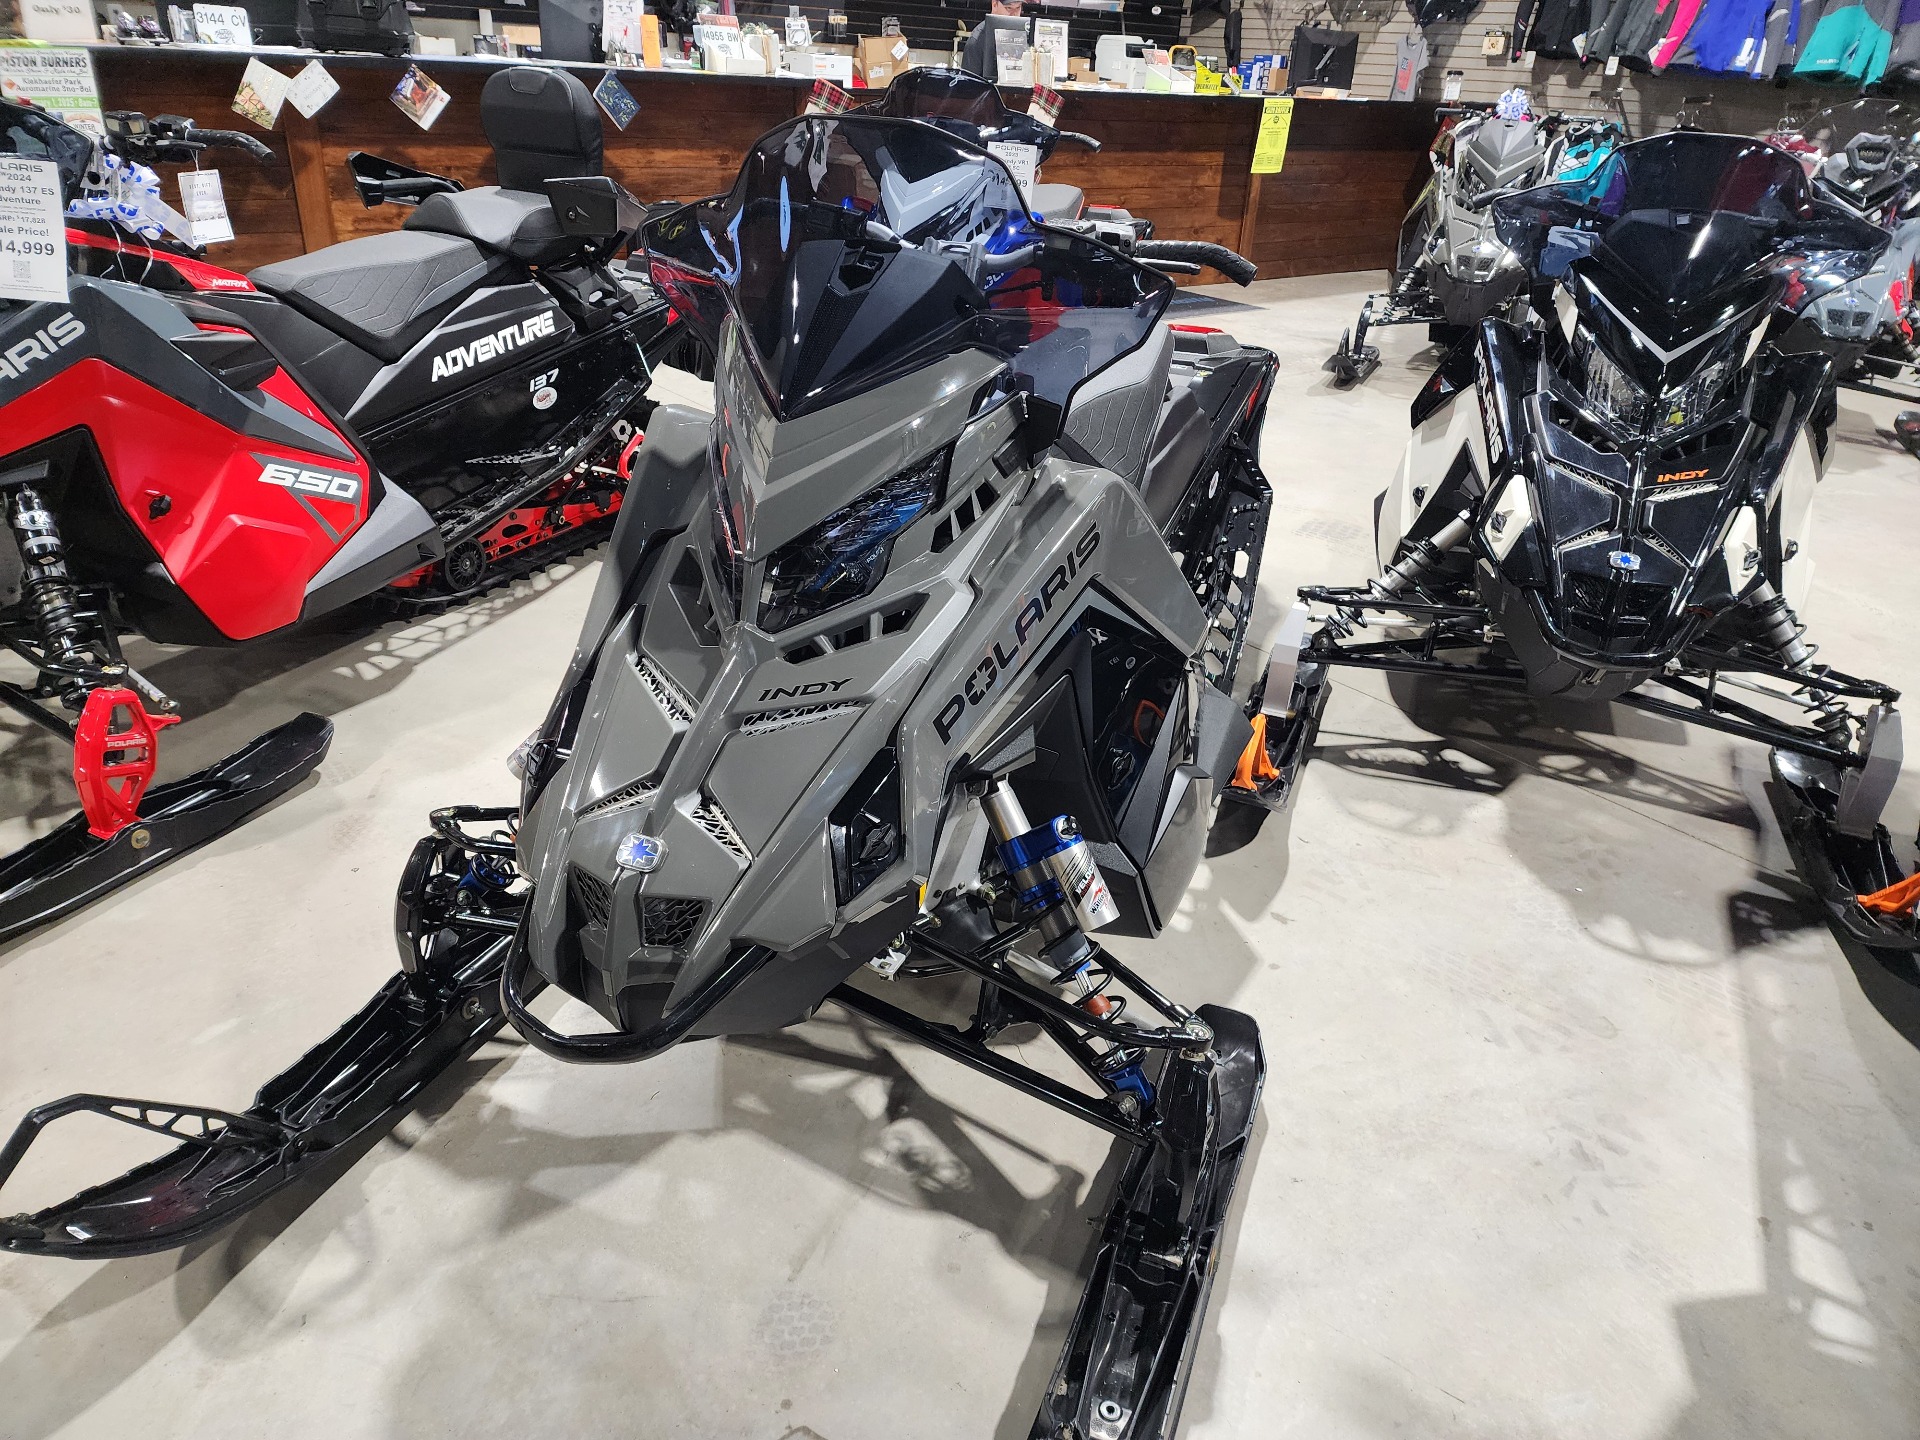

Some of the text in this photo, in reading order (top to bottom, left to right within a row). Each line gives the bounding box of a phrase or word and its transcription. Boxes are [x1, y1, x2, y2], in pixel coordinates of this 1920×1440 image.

[196, 11, 246, 27] 3144 CV
[41, 56, 87, 68] BURNERS
[64, 78, 82, 86] Park
[73, 122, 96, 131] WINTER
[995, 144, 1030, 152] POLARIS
[7, 172, 32, 182] 2024
[20, 185, 38, 194] 137
[41, 187, 55, 196] ES
[17, 226, 50, 237] Price!
[211, 278, 250, 290] MATRYX
[431, 310, 556, 383] ADVENTURE
[529, 367, 560, 393] 137
[1473, 338, 1504, 464] POLARIS
[258, 463, 359, 499] 650
[1656, 468, 1710, 483] INDY
[931, 520, 1102, 746] POLARIS
[757, 677, 854, 702] INDY
[107, 737, 148, 748] POLARIS
